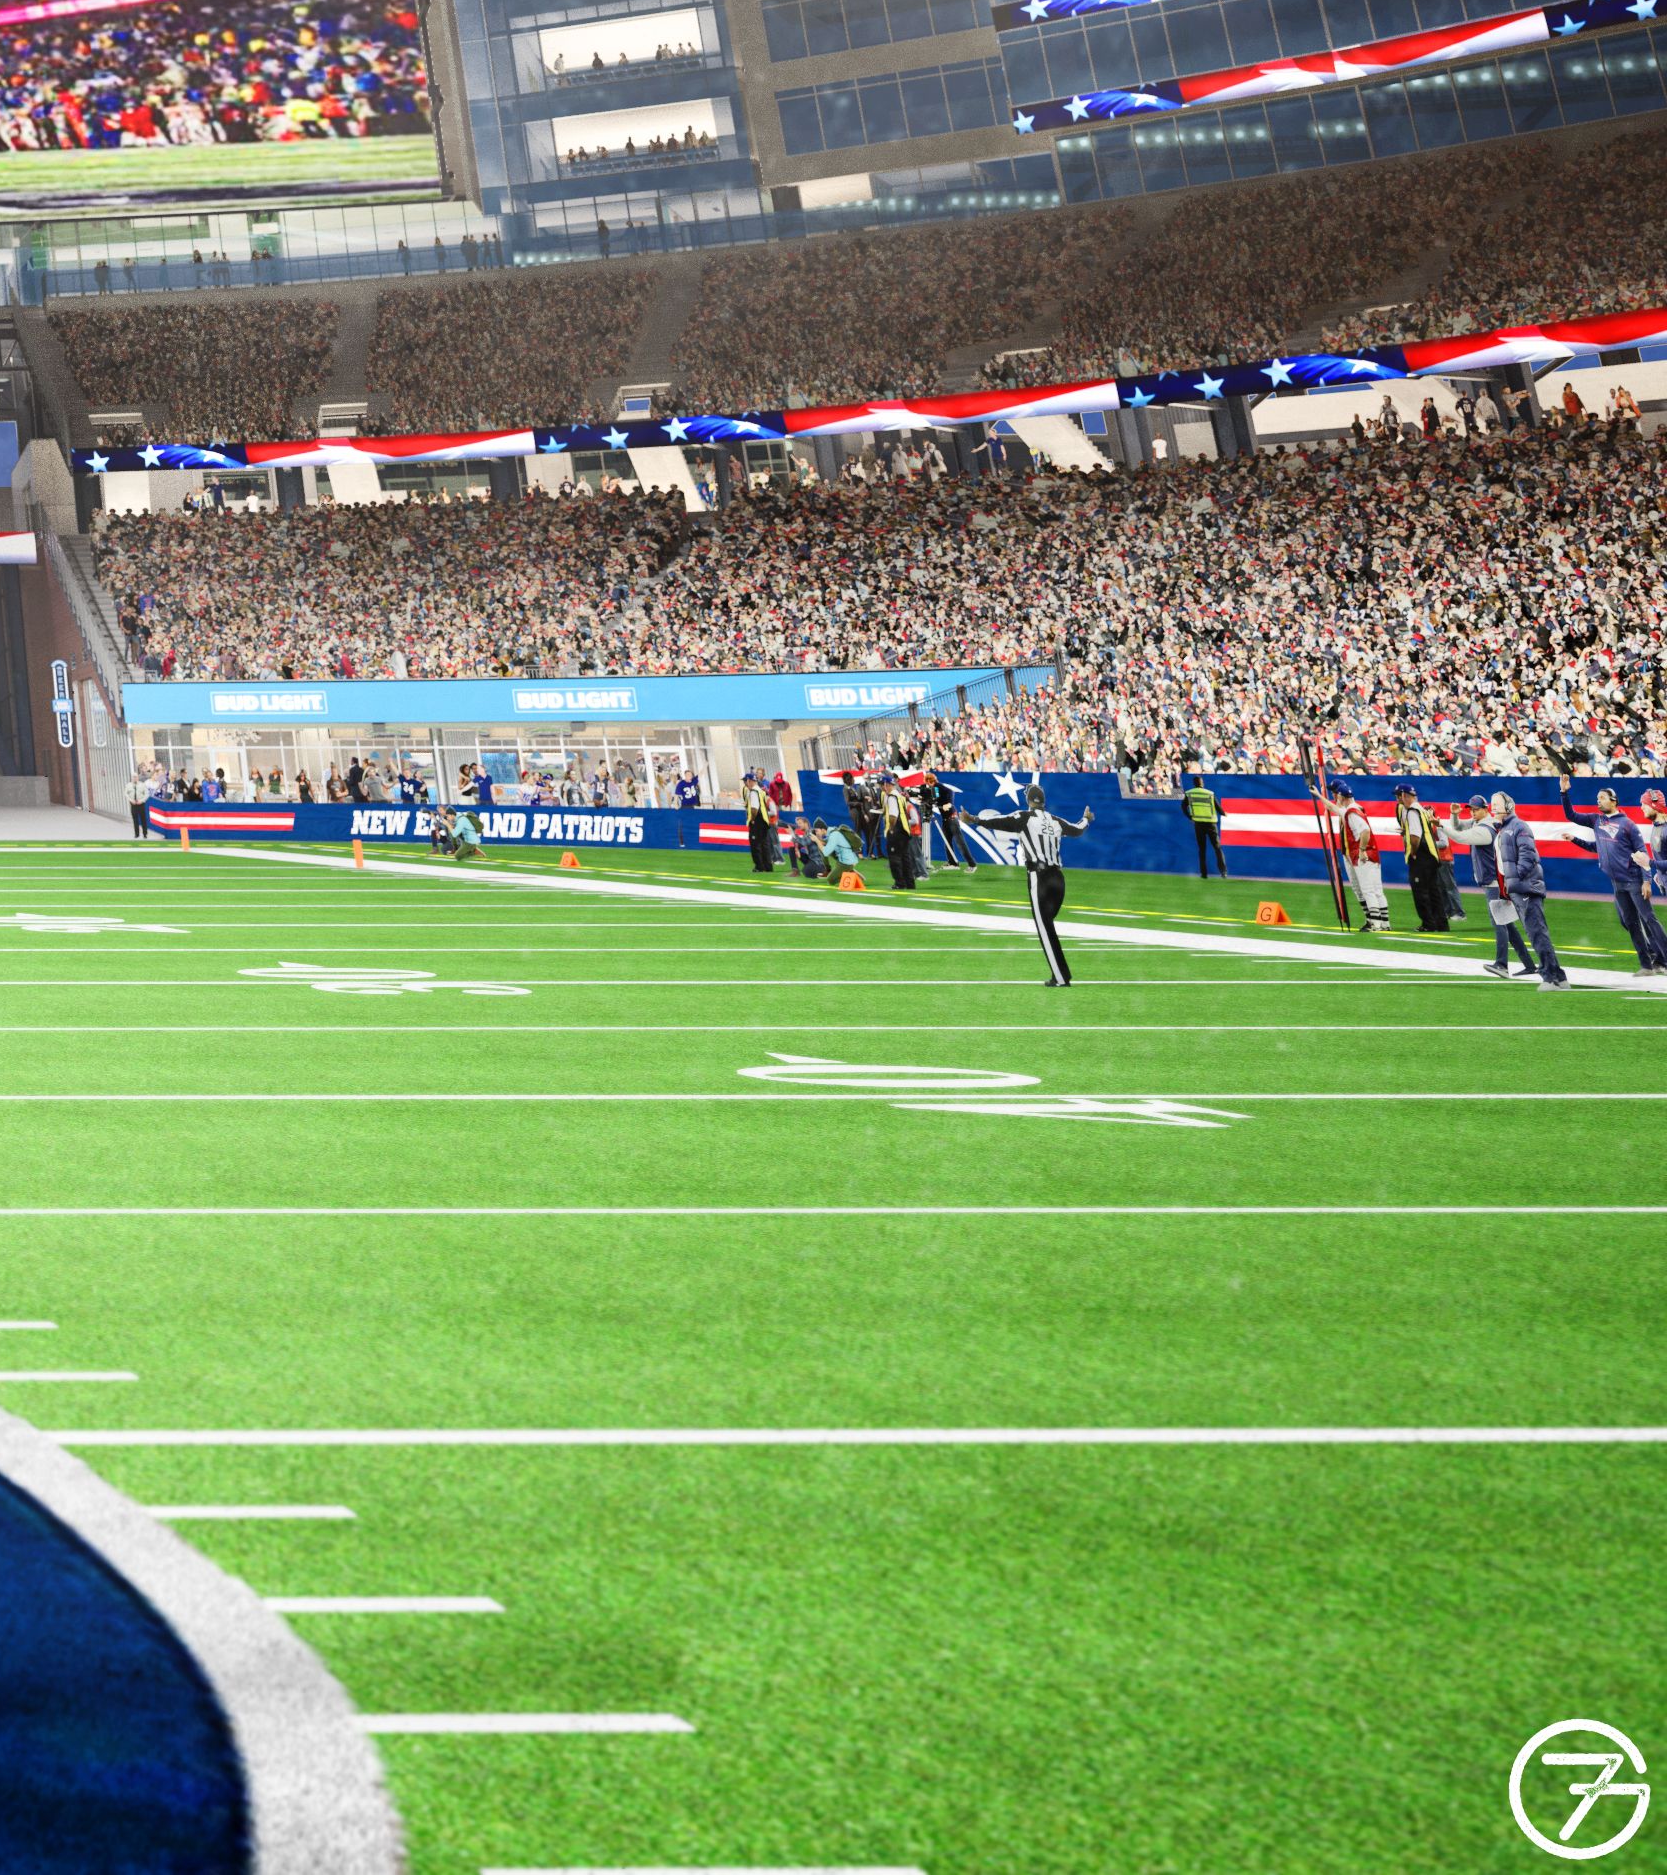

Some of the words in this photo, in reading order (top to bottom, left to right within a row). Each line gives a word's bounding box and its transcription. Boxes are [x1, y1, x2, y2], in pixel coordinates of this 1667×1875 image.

[214, 694, 259, 711] BUD
[517, 692, 564, 709] BUD
[809, 688, 857, 706] BUD
[859, 686, 927, 705] LIGHT
[60, 713, 70, 743] HALL
[683, 786, 697, 799] 34
[351, 810, 411, 835] NEW
[414, 810, 527, 839] EAND
[531, 813, 645, 843] PATRIOTS
[1260, 906, 1273, 922] G
